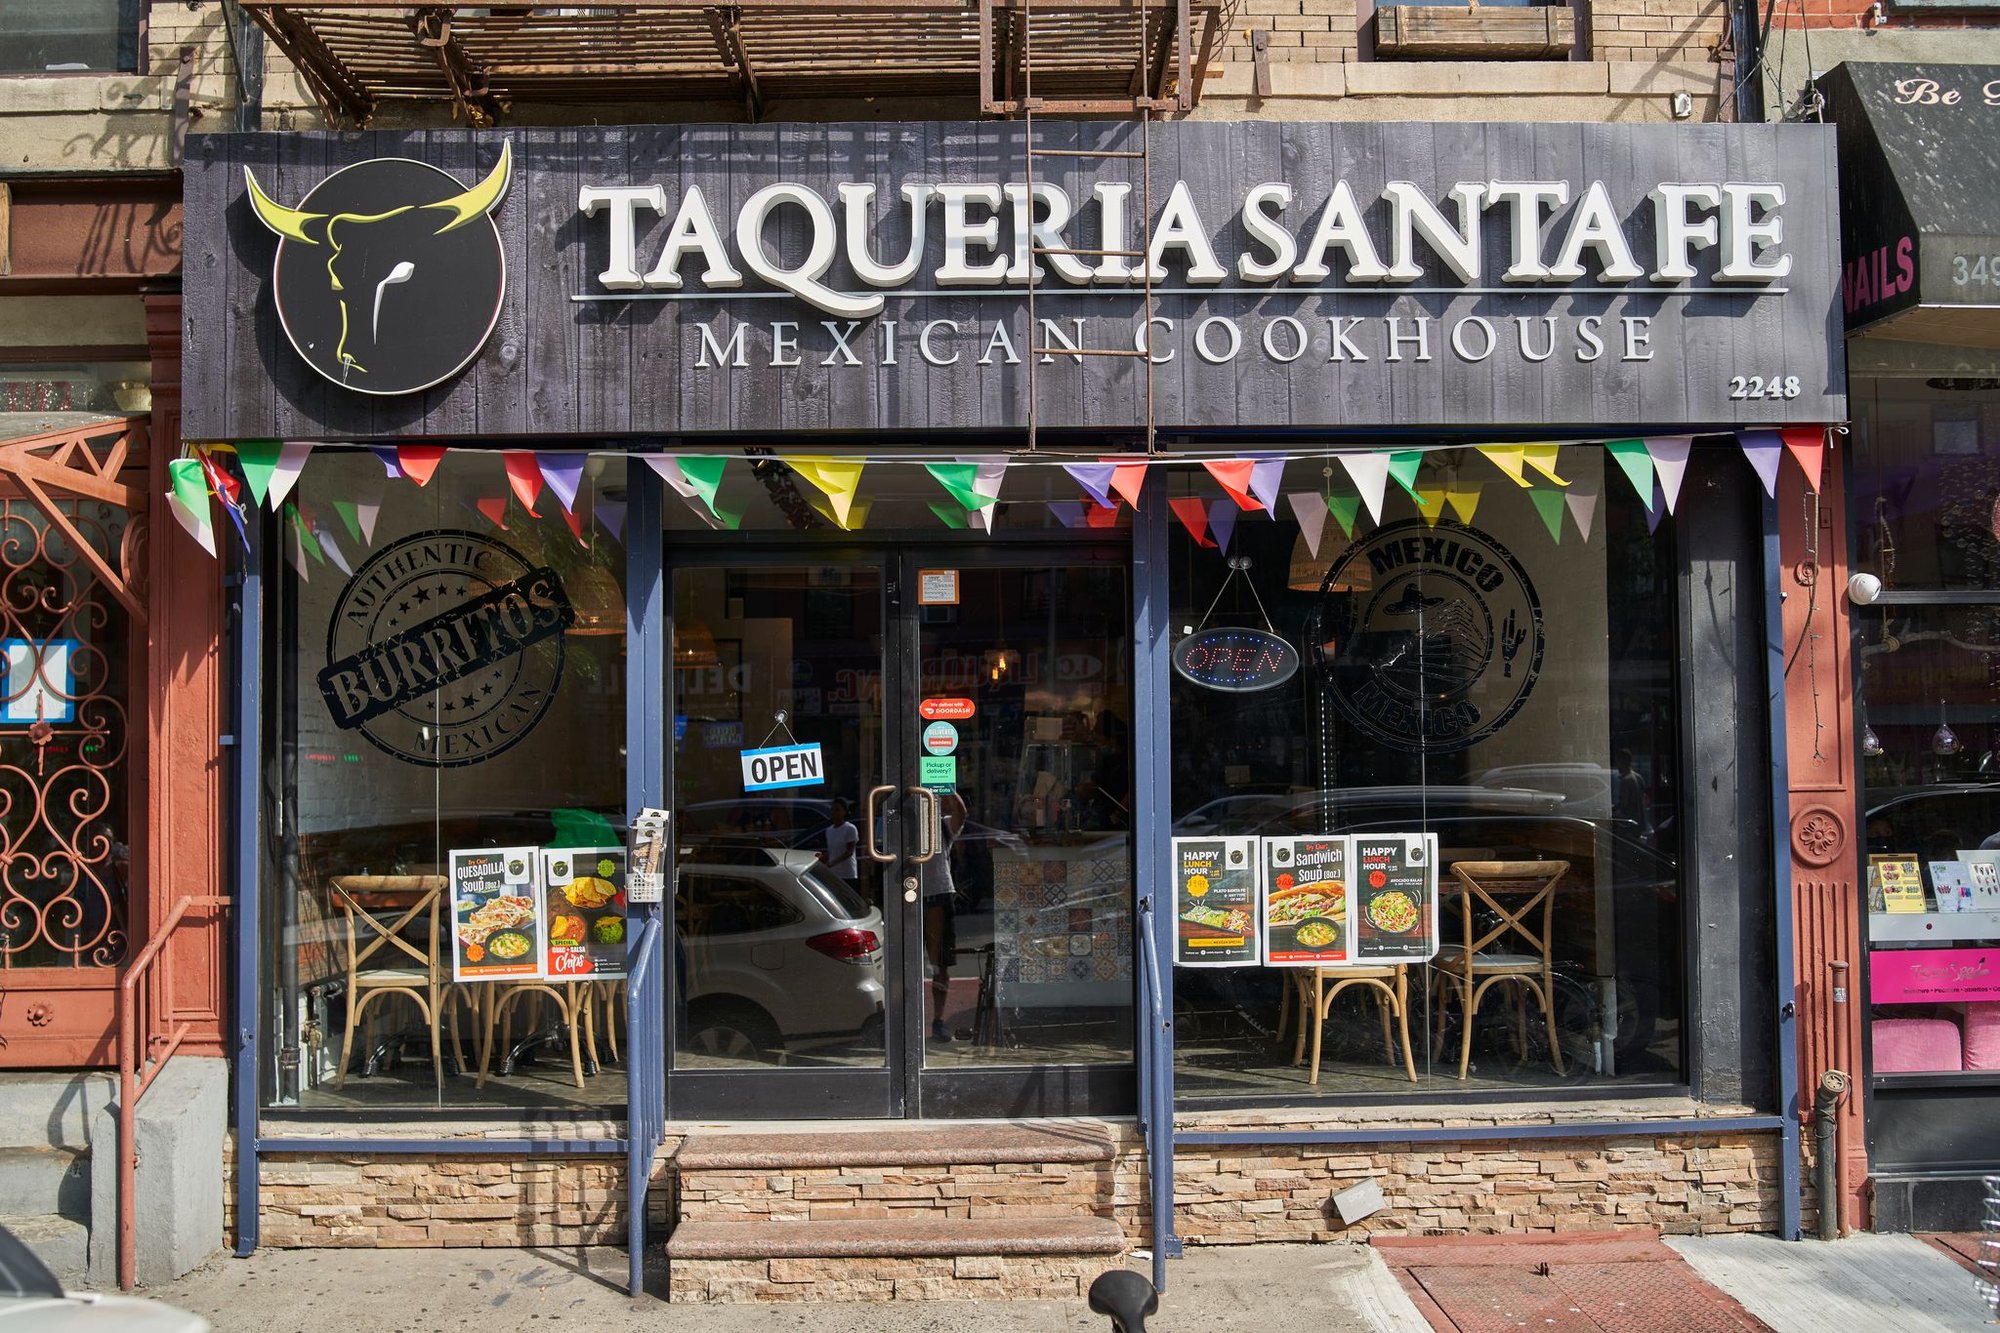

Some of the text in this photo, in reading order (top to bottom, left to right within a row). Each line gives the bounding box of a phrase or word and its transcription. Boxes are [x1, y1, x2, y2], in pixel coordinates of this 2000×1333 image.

[1894, 78, 1962, 106] Be
[578, 180, 1228, 319] TAQUERIA
[1843, 236, 1914, 313] NAILS
[694, 315, 1655, 367] MEXICAN COOKHOUSE
[1729, 375, 1801, 399] 2248
[1366, 536, 1505, 593] MEXICO
[346, 542, 492, 629] AUTHENTIC
[327, 580, 562, 720] BURRITOS
[1185, 646, 1284, 673] OPEN
[412, 681, 543, 755] MEXICAN
[1351, 679, 1482, 737] MEXICO
[751, 751, 818, 784] OPEN
[1183, 851, 1219, 860] HAPPY
[1183, 860, 1212, 868] LUNCH
[1296, 849, 1342, 867] Sandwich
[1362, 847, 1397, 856] HAPPY
[457, 861, 505, 880] QUESADILLA
[1298, 868, 1323, 882] Soup
[555, 952, 585, 973] Chips
